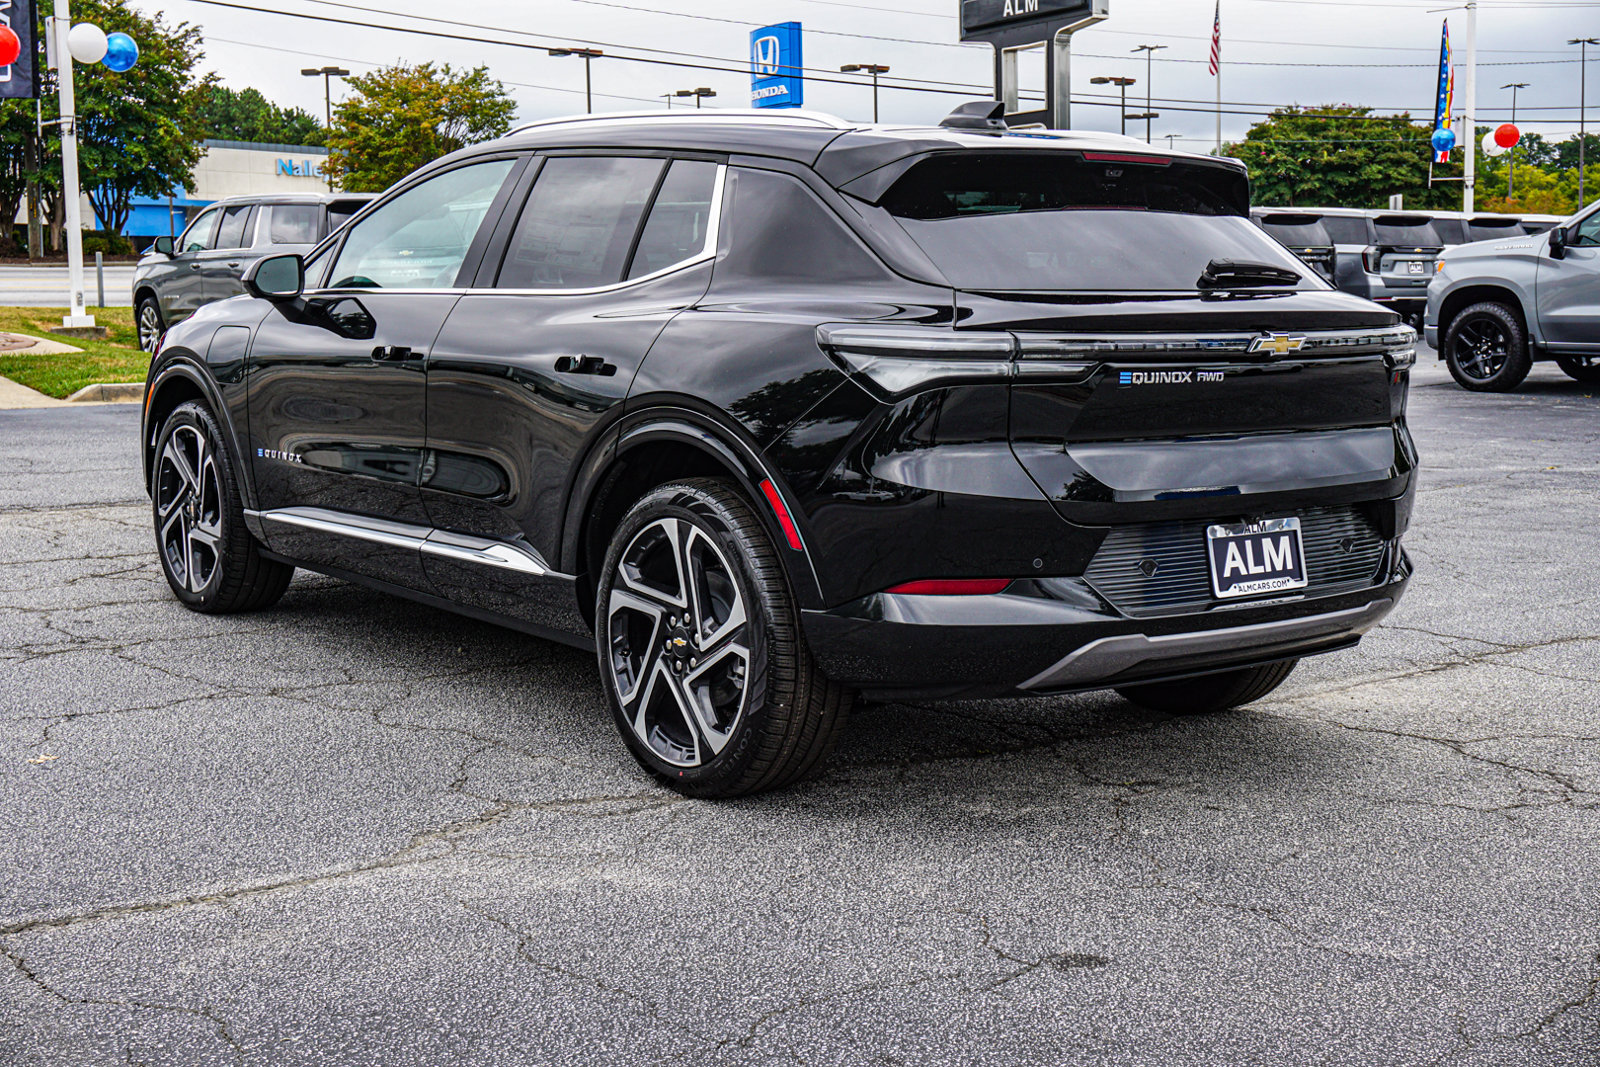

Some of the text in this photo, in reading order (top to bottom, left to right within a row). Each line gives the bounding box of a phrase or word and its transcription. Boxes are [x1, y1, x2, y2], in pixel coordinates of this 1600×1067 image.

[1002, 0, 1039, 17] ALM
[752, 84, 789, 101] HONDA
[1119, 371, 1193, 385] EQUINOX
[257, 448, 302, 463] EQUINOX
[1243, 521, 1267, 534] ALM
[1223, 535, 1294, 578] ALM
[1238, 580, 1288, 593] ALMCARS.COM
